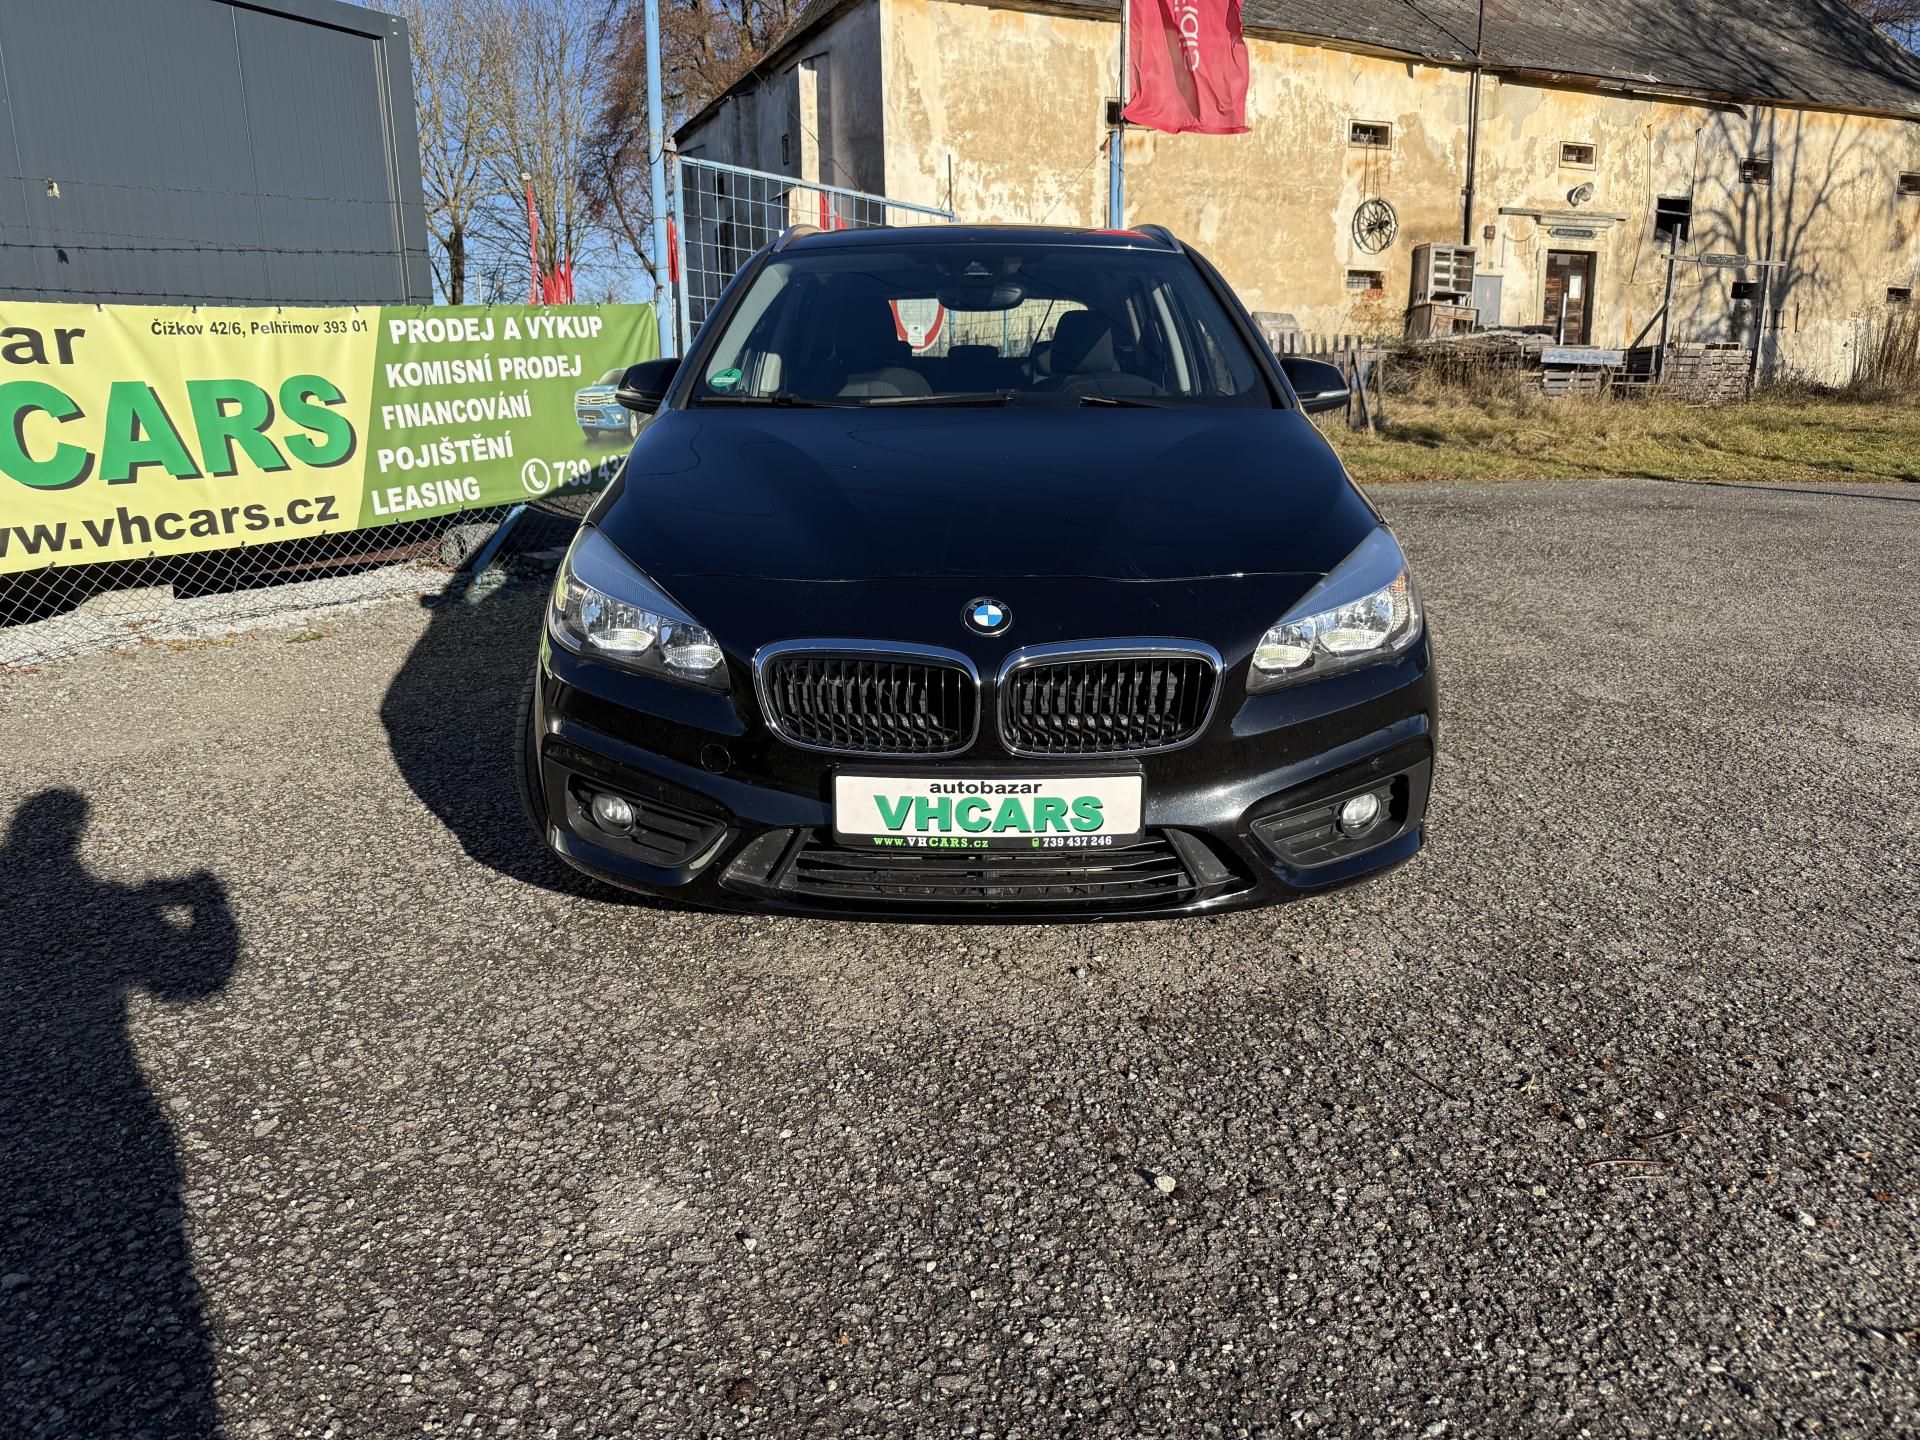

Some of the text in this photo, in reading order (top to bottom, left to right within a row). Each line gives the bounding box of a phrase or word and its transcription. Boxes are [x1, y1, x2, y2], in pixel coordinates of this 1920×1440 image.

[151, 318, 369, 338] Čížkov 42/6, Pelhřimov 393 01
[388, 312, 603, 345] PRODEJ A VÝKUP
[0, 327, 86, 365] ar
[384, 353, 582, 388] KOMISNÍ PRODEJ
[381, 389, 532, 430] FINANCOVÁNÍ
[0, 374, 357, 490] CARS
[377, 430, 514, 473] POJIŠTĚNÍ
[552, 458, 592, 488] 739
[371, 476, 481, 516] LEASING
[0, 495, 340, 558] w.vhcars.cz
[969, 600, 1008, 611] BMW
[929, 780, 1043, 795] autobazar
[873, 795, 1105, 833] VHCARS
[873, 836, 989, 848] www.VHCARS.cz
[1043, 835, 1113, 848] 739 437 246
